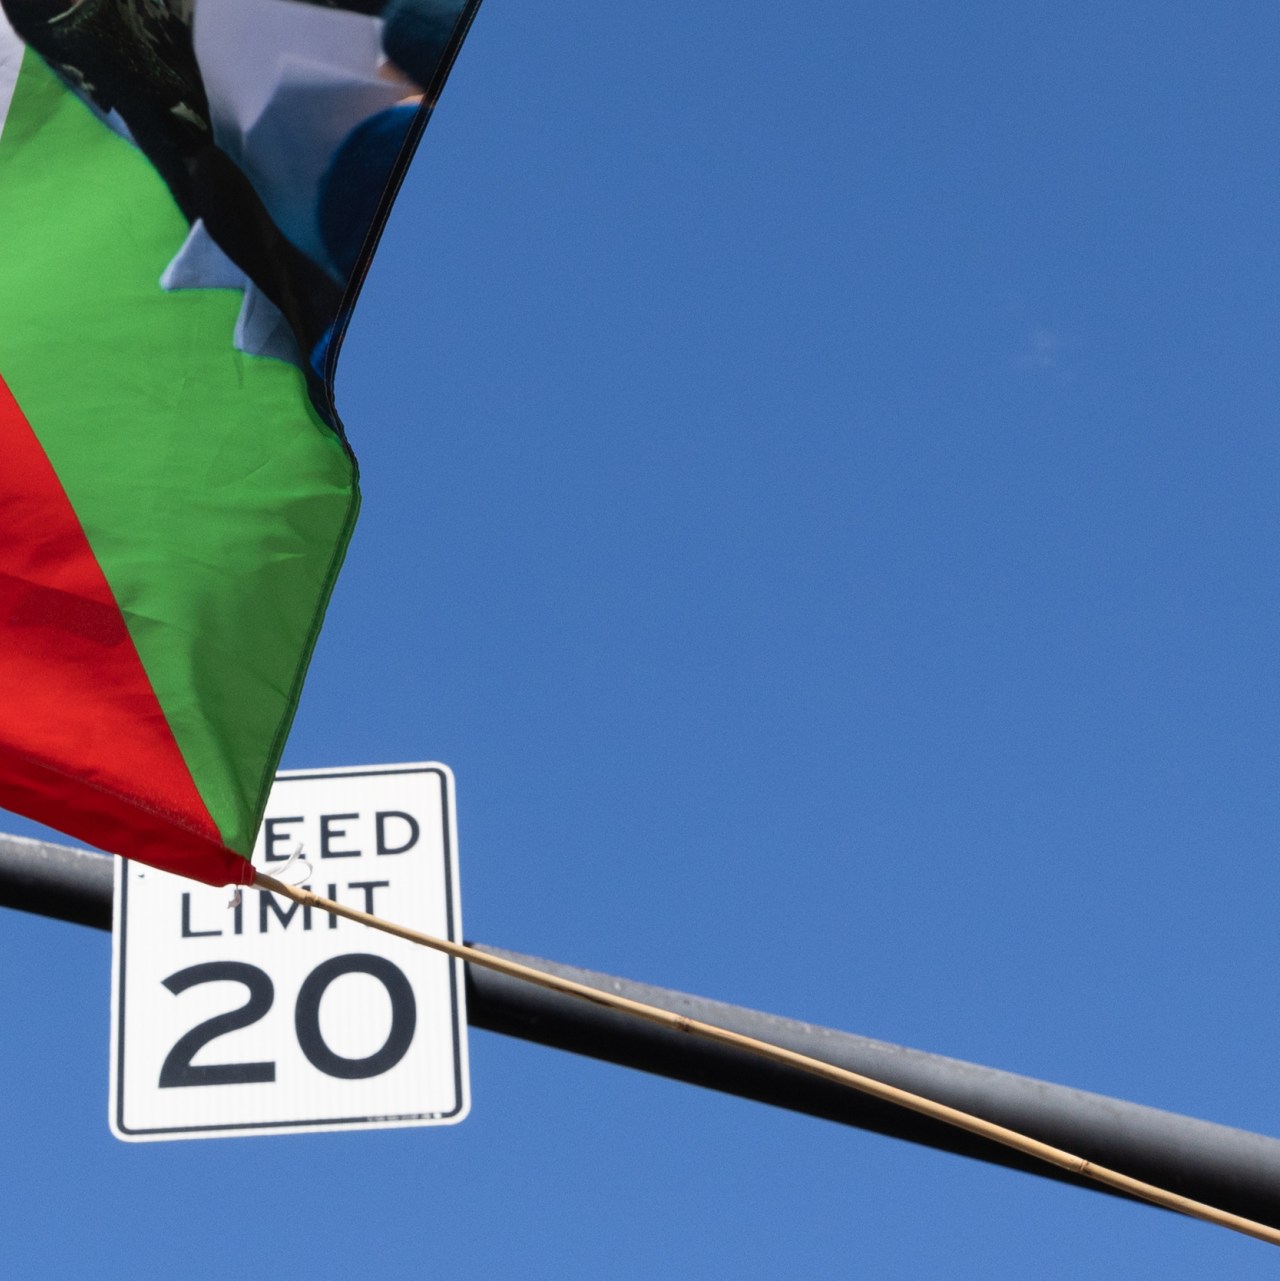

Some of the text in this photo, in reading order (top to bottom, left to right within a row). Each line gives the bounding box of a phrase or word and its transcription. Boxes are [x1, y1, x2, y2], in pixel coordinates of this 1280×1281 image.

[264, 811, 420, 862] EED
[181, 879, 390, 938] LIMIT
[159, 953, 417, 1088] 20
